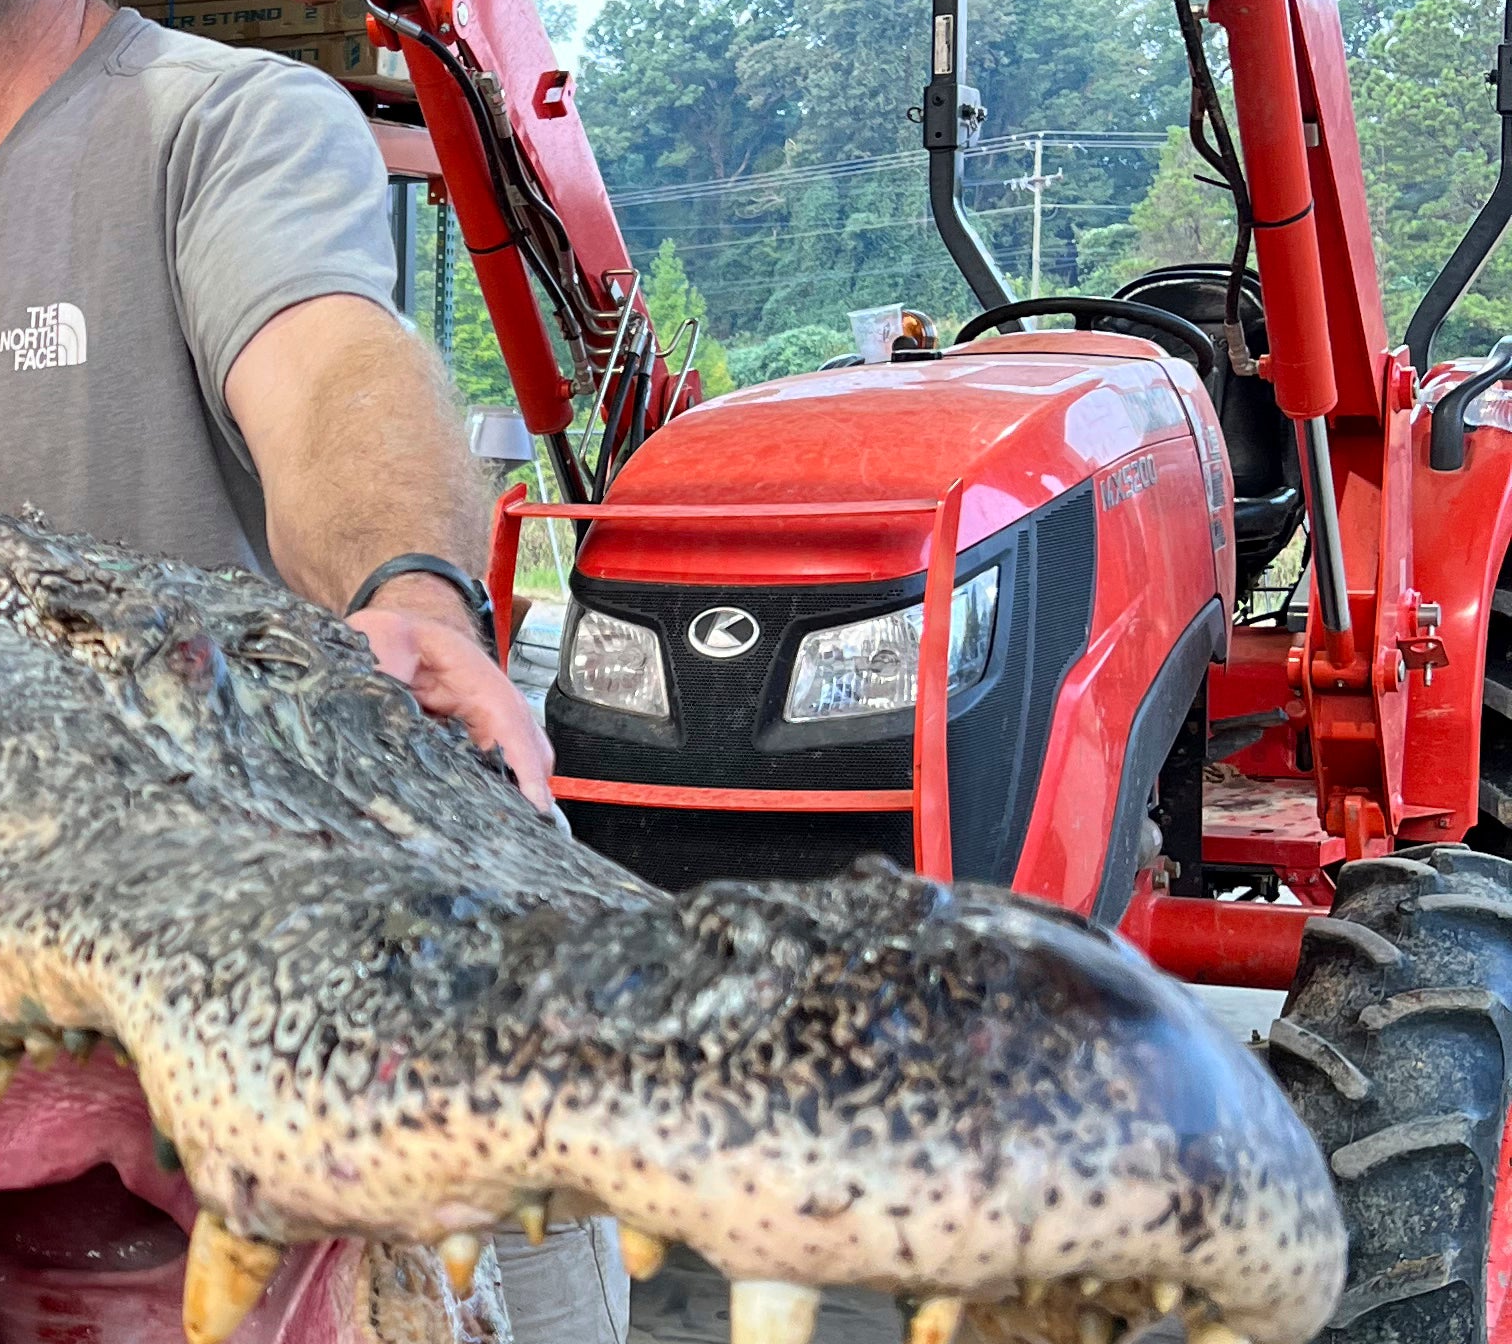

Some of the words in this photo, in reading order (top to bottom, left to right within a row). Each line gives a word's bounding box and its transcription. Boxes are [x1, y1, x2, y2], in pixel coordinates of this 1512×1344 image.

[202, 7, 283, 27] STAND
[26, 303, 58, 329] THE
[0, 325, 58, 353] NORTH
[14, 345, 58, 372] FACE
[1099, 453, 1159, 513] MX5200
